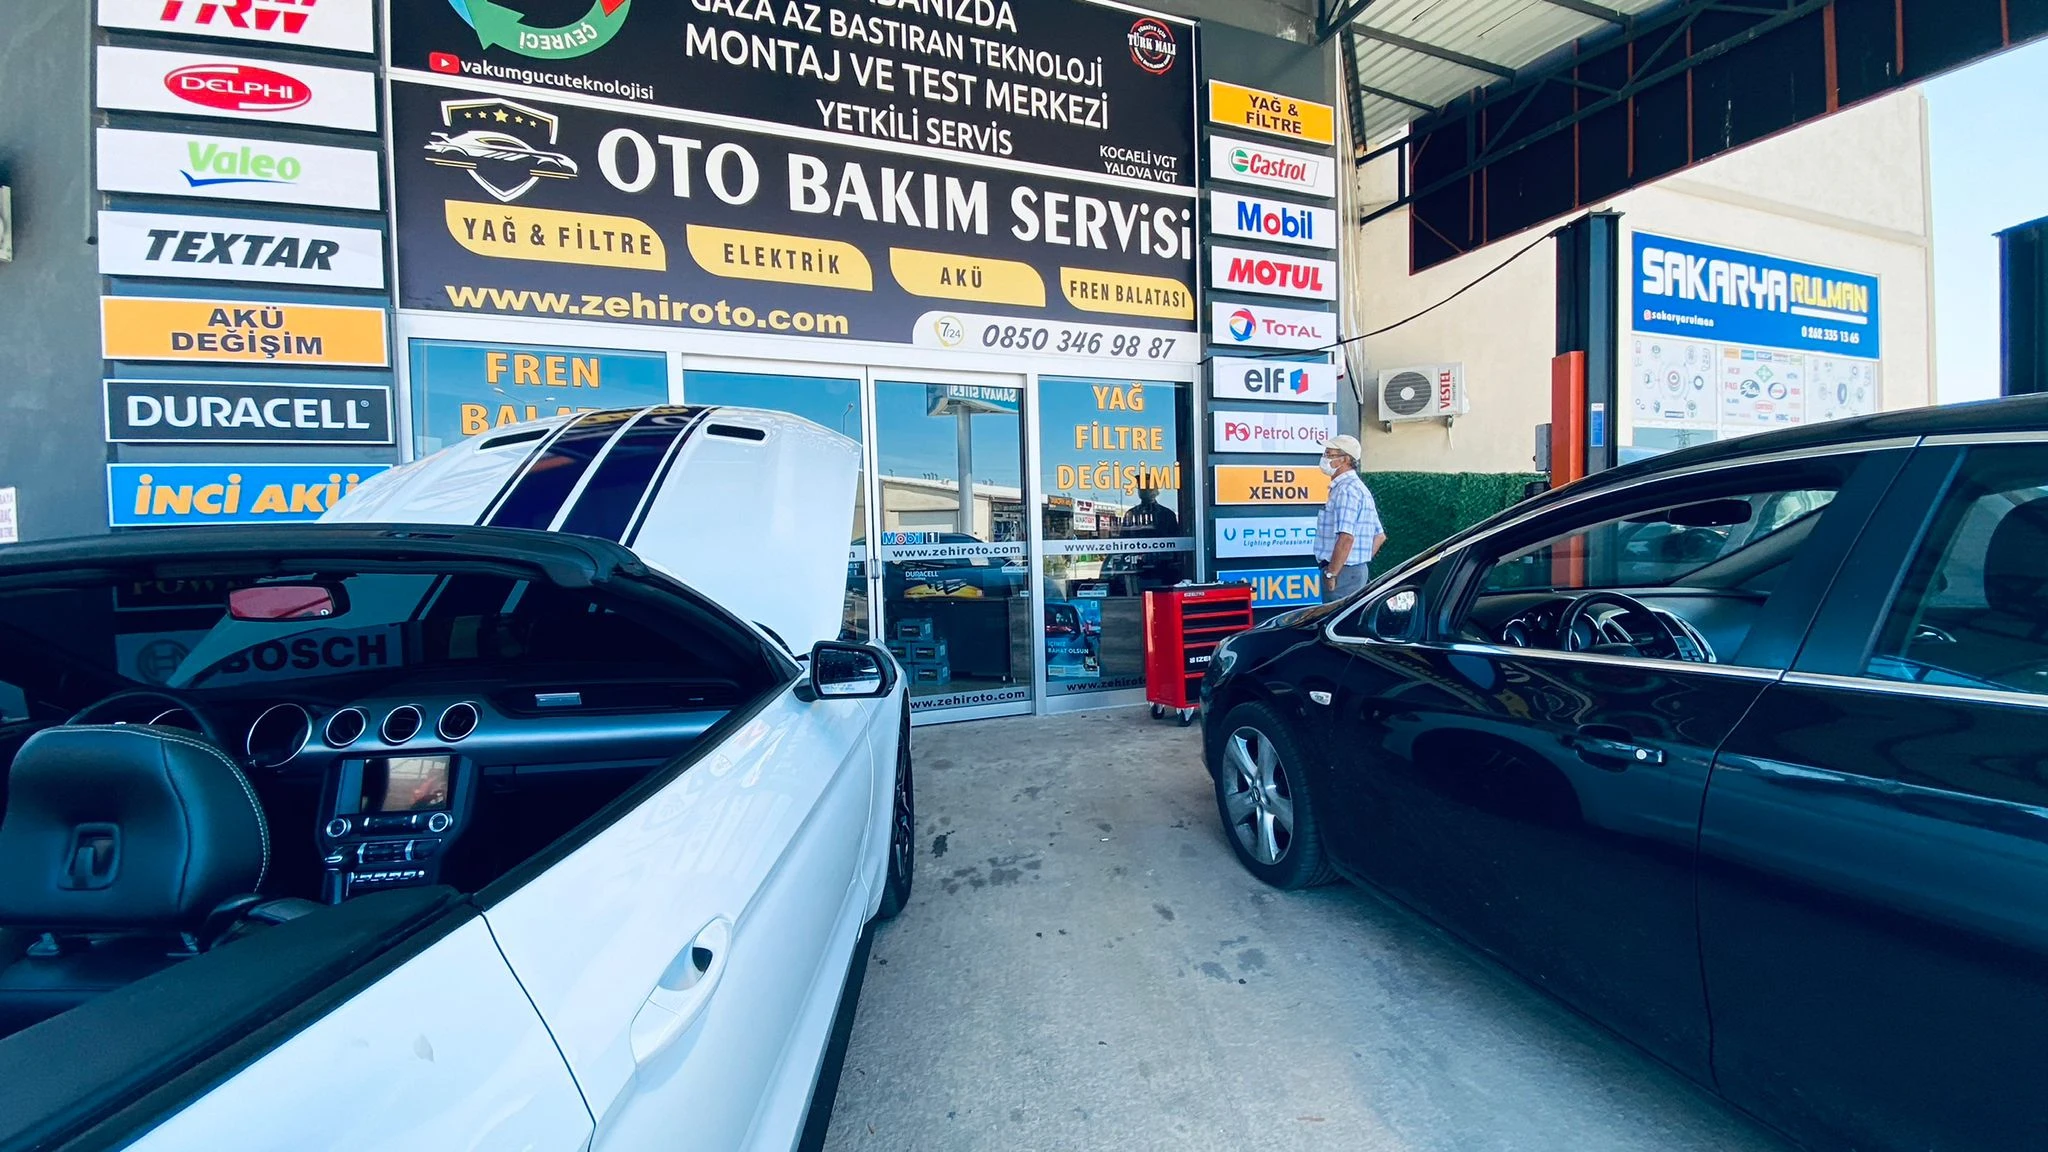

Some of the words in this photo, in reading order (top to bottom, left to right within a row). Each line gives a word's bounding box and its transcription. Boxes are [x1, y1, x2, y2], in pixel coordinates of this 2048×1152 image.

[869, 0, 1018, 33] NIZDA
[519, 22, 598, 50] ÇEVRECİ
[781, 3, 822, 33] AZ
[828, 8, 965, 60] BASTIRAN
[970, 36, 1102, 88] TEKNOLOJİ
[1127, 32, 1153, 50] TÜRK
[1154, 40, 1176, 56] MALI
[180, 75, 293, 99] DELPHI
[460, 59, 654, 100] vakumgucuteknolojisi
[685, 23, 840, 83] MONTAJ
[850, 52, 895, 91] VE
[902, 62, 977, 106] TEST
[985, 79, 1108, 130] MERKEZİ
[1248, 93, 1282, 113] YAĞ
[1287, 103, 1299, 117] &
[816, 98, 919, 142] YETKİLİ
[926, 118, 1013, 156] SERVİS
[1246, 109, 1302, 134] FİLTRE
[187, 141, 300, 181] Valeo
[1099, 144, 1151, 166] KOCAELİ
[1152, 153, 1177, 169] VGT
[1250, 153, 1306, 182] Castrol
[597, 127, 760, 205] OTO
[787, 152, 989, 236] BAKIM
[1104, 161, 1151, 180] YALOVA
[1152, 168, 1178, 184] VGT
[1237, 201, 1313, 239] Mobil
[145, 229, 340, 271] TEXTAR
[462, 216, 517, 244] YAĞ
[530, 225, 545, 246] &
[559, 222, 652, 256] FİLTRE
[723, 242, 841, 276] ELEKTRİK
[940, 266, 983, 289] AKÜ
[1228, 258, 1323, 292] MOTUL
[1641, 247, 1788, 314] SAKARYA
[1790, 272, 1868, 314] RULMAN
[1070, 279, 1110, 302] FREN
[1115, 286, 1186, 309] BALATASI
[207, 306, 284, 330] AKÜ
[444, 285, 849, 336] www.zehiroto.com
[171, 329, 323, 359] DEĞİŞİM
[982, 323, 1049, 351] 0850
[1056, 329, 1103, 355] 346
[1110, 333, 1141, 358] 98
[1149, 336, 1177, 360] 87
[485, 351, 600, 389] FREN
[1244, 367, 1285, 393] elf
[1092, 382, 1145, 412] YAĞ
[1440, 369, 1451, 409] VESTEL
[1075, 421, 1164, 451] FİLTRE
[1254, 425, 1294, 440] Petrol
[1298, 427, 1328, 441] Ofisi
[1056, 461, 1182, 497] DEĞİŞİMİ
[1263, 470, 1296, 483] LED
[134, 473, 242, 515] İNCİ
[1249, 486, 1309, 500] XENON
[882, 531, 924, 545] Mobil
[893, 545, 1021, 558] www.zehiroto.com
[1065, 541, 1176, 552] www.zehiroto.com
[1243, 539, 1271, 548] Lighting
[905, 570, 939, 578] DURACELL
[910, 690, 1025, 709] ww.zehiroto.com
